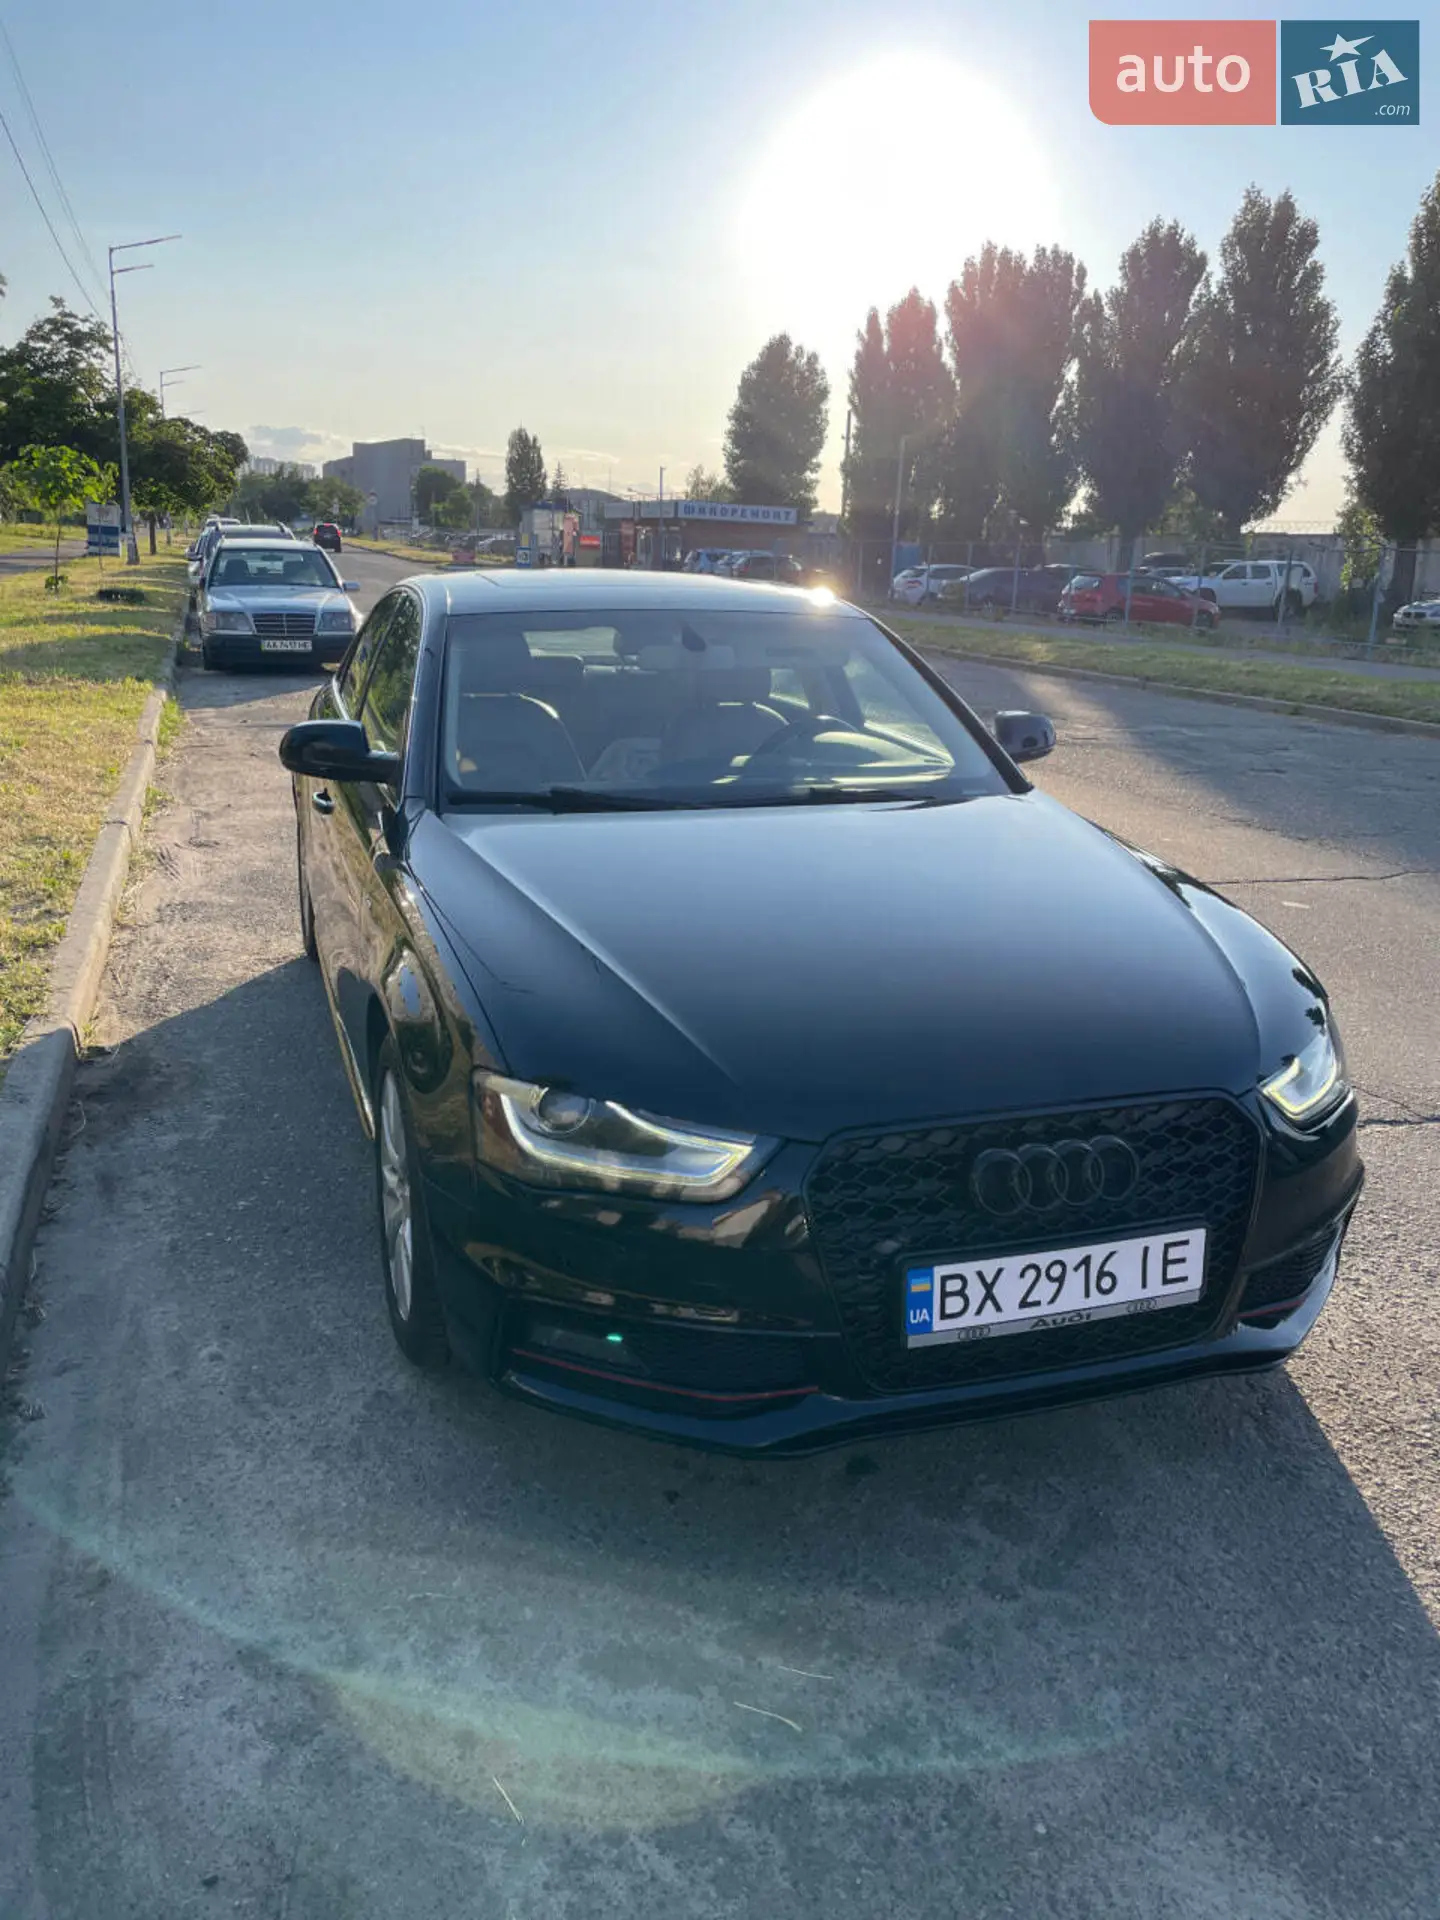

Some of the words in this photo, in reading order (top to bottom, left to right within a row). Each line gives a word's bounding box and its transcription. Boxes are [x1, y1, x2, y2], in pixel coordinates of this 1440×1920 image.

[939, 1267, 1005, 1321] BX
[1018, 1250, 1118, 1310] 2916
[1141, 1239, 1190, 1289] IE
[909, 1308, 930, 1324] UA
[1030, 1311, 1092, 1329] Audi
